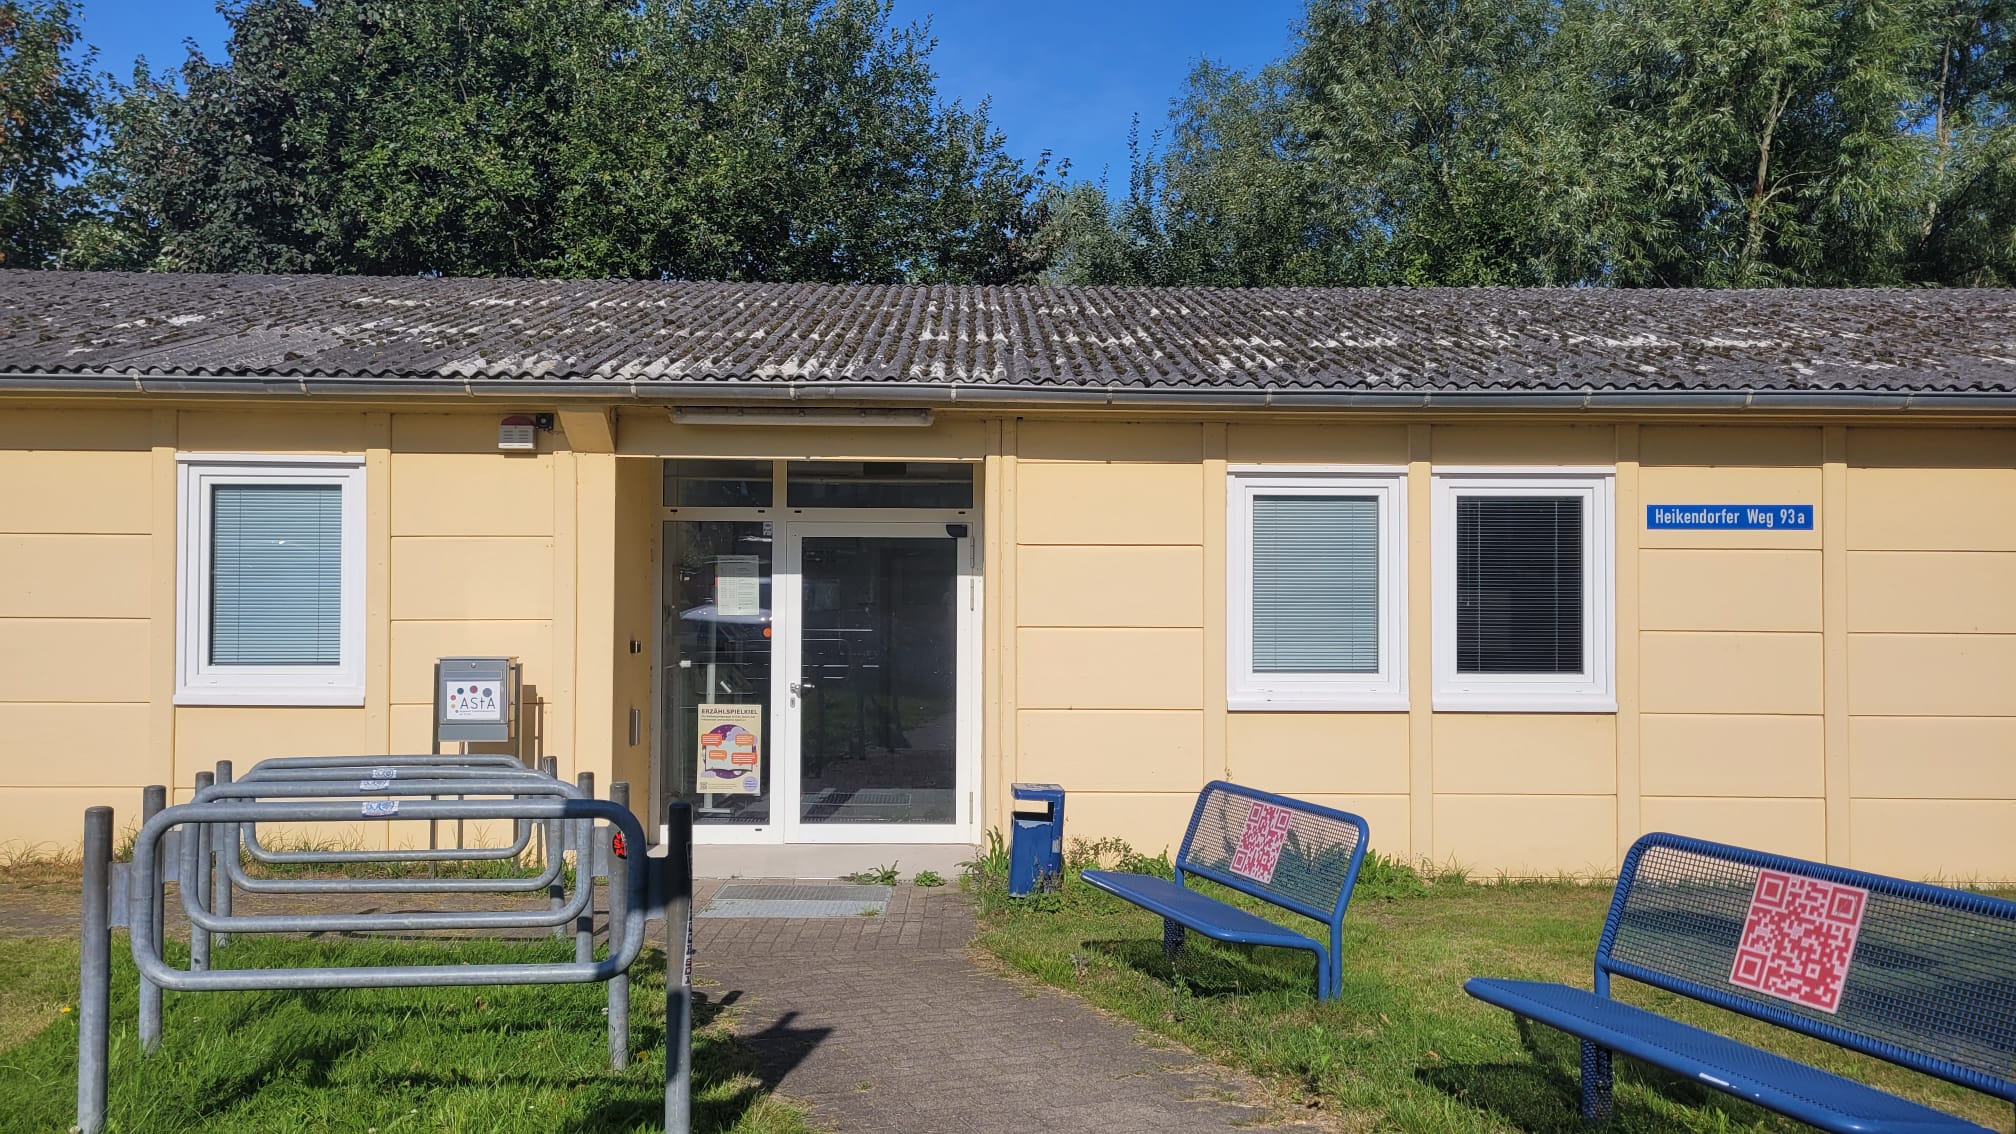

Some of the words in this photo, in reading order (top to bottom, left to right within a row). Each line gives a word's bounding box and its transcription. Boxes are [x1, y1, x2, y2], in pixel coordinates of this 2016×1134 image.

[1655, 508, 1740, 524] Heikendorfer
[1746, 508, 1774, 527] Weg
[460, 697, 496, 710] AStA
